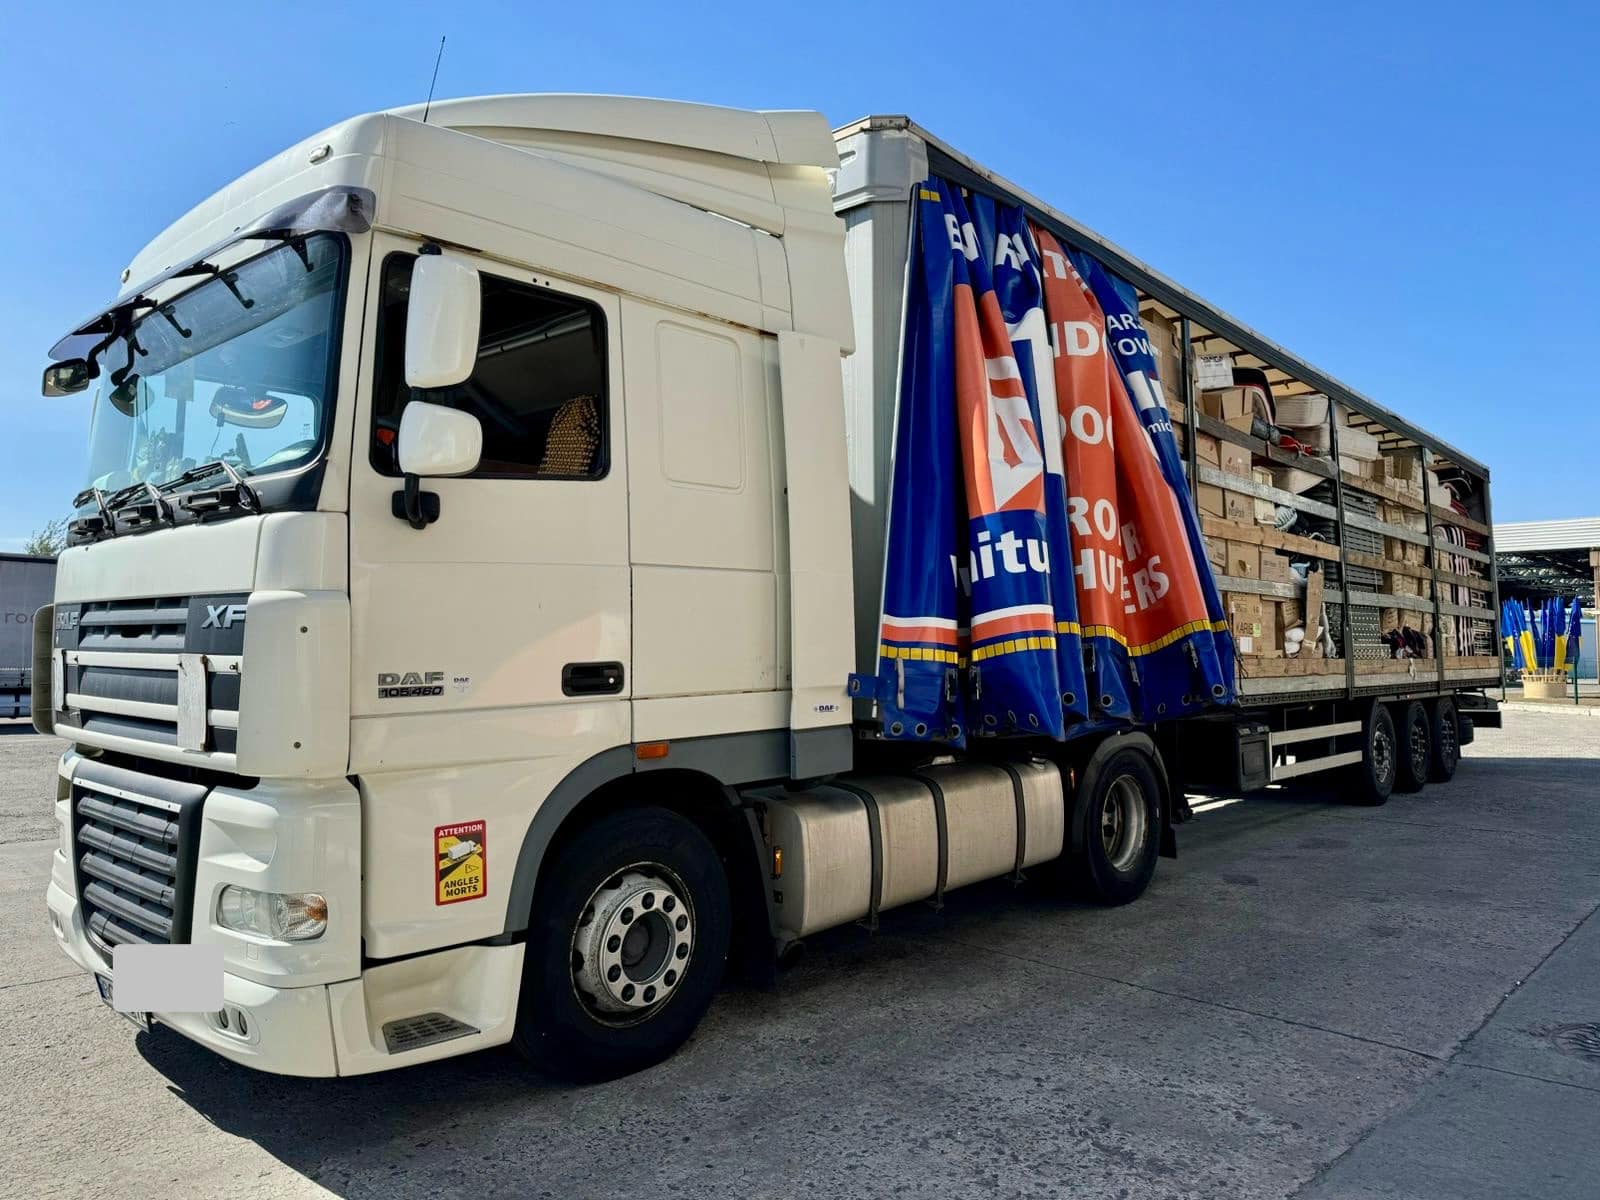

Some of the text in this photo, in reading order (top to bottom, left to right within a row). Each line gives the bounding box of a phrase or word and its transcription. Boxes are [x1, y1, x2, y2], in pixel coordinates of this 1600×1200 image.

[201, 604, 249, 629] XF
[378, 672, 444, 686] DAF
[438, 823, 483, 838] ATTENTION
[444, 875, 480, 889] ANGLES
[445, 884, 478, 897] MORTS
